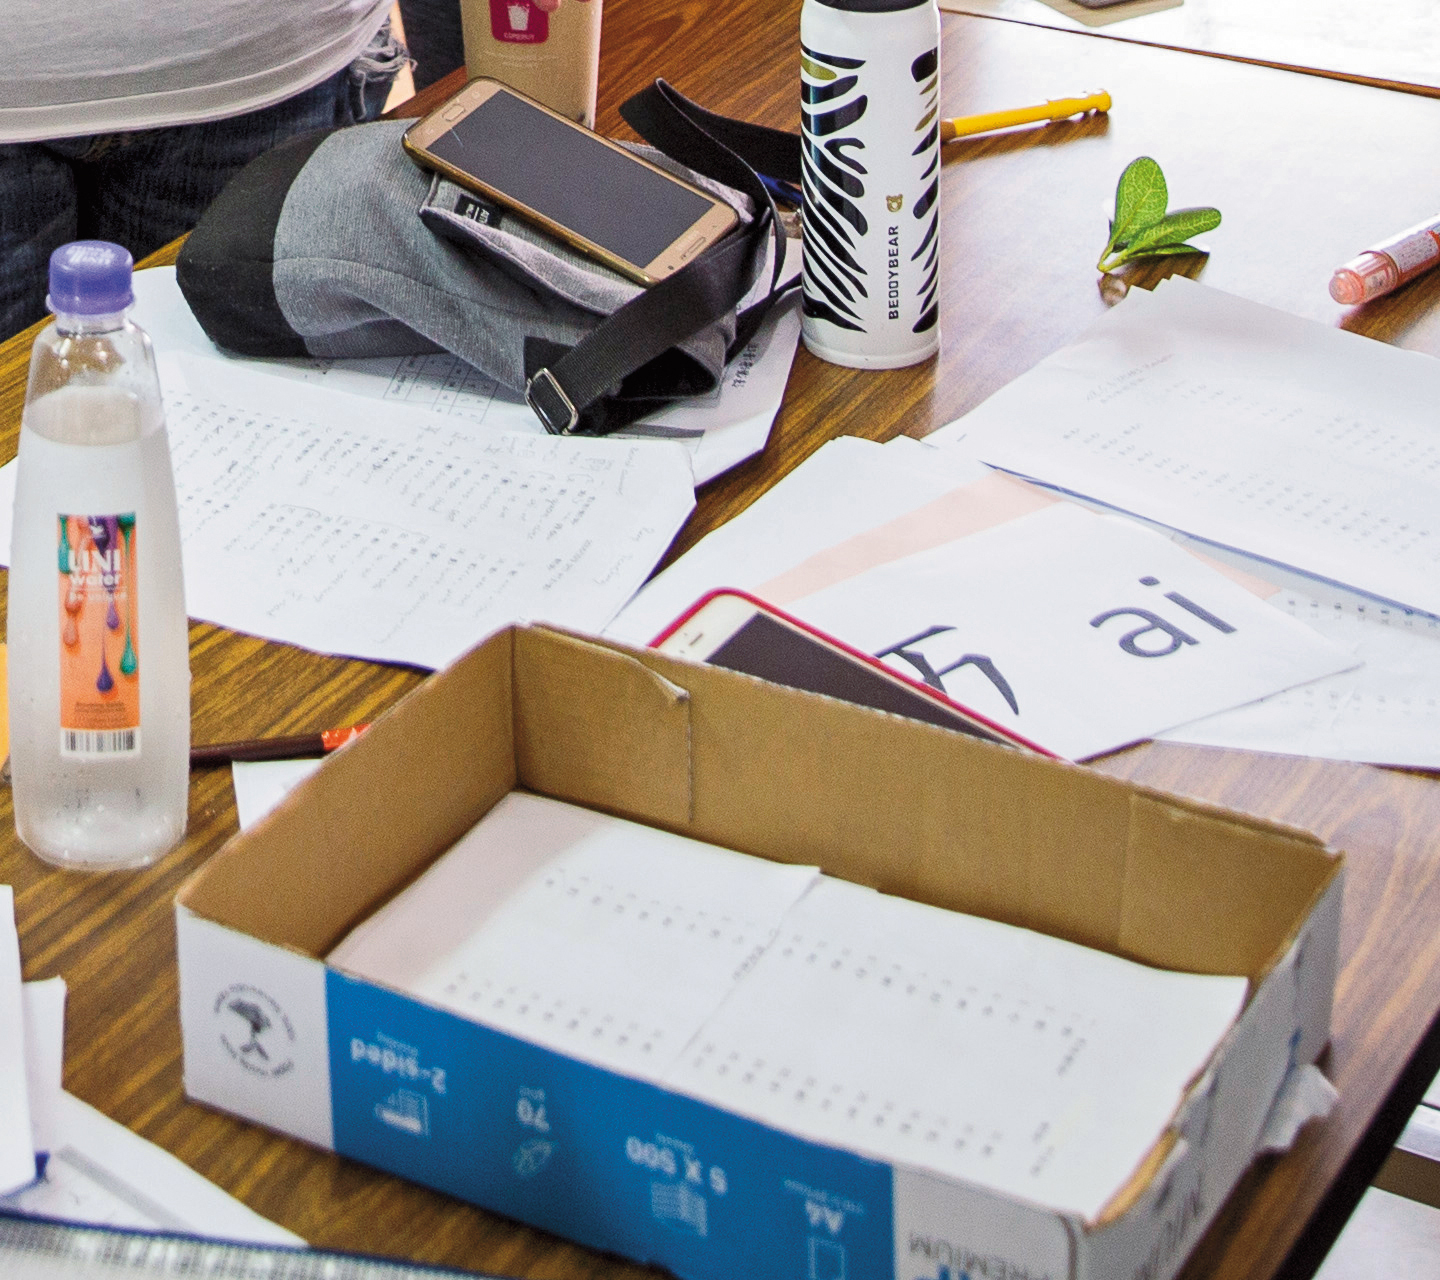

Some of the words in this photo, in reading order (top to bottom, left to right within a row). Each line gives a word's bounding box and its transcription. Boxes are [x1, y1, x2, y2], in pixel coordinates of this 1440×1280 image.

[888, 225, 899, 320] BEDDYBEAR
[1089, 575, 1238, 658] ai
[349, 1037, 447, 1095] 2-sided
[516, 1097, 551, 1133] 70
[624, 1135, 677, 1178] 500
